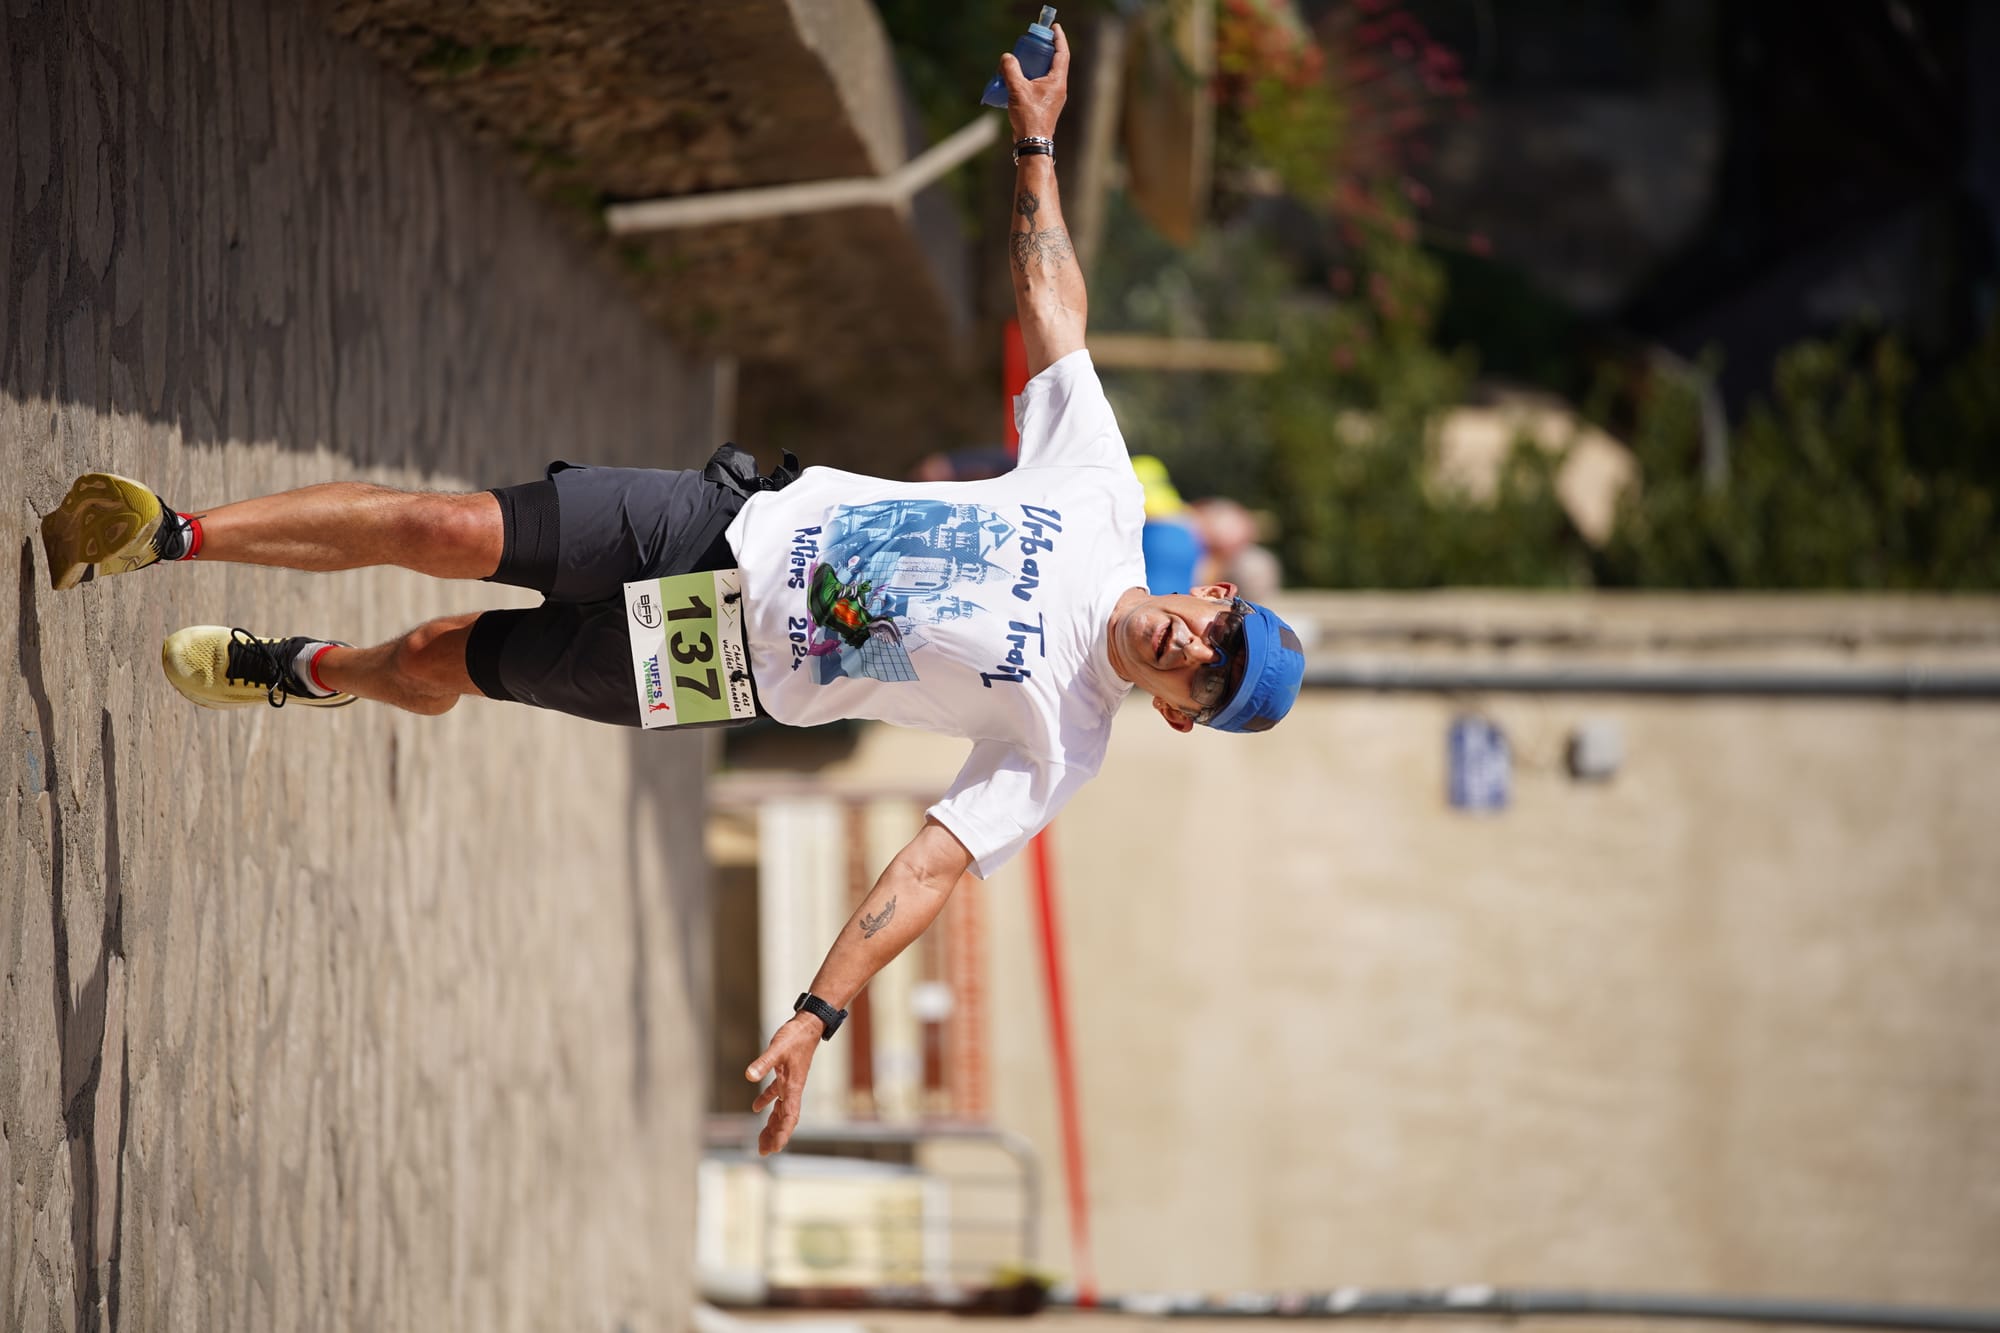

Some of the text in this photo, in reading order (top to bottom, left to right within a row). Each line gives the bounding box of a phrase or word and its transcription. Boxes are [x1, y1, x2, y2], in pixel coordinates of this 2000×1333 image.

[640, 594, 653, 624] BFP
[667, 595, 721, 700] 137
[788, 616, 808, 672] 2024
[642, 661, 654, 704] Aventure
[649, 655, 662, 699] TUFF'S
[732, 644, 750, 706] Challge des
